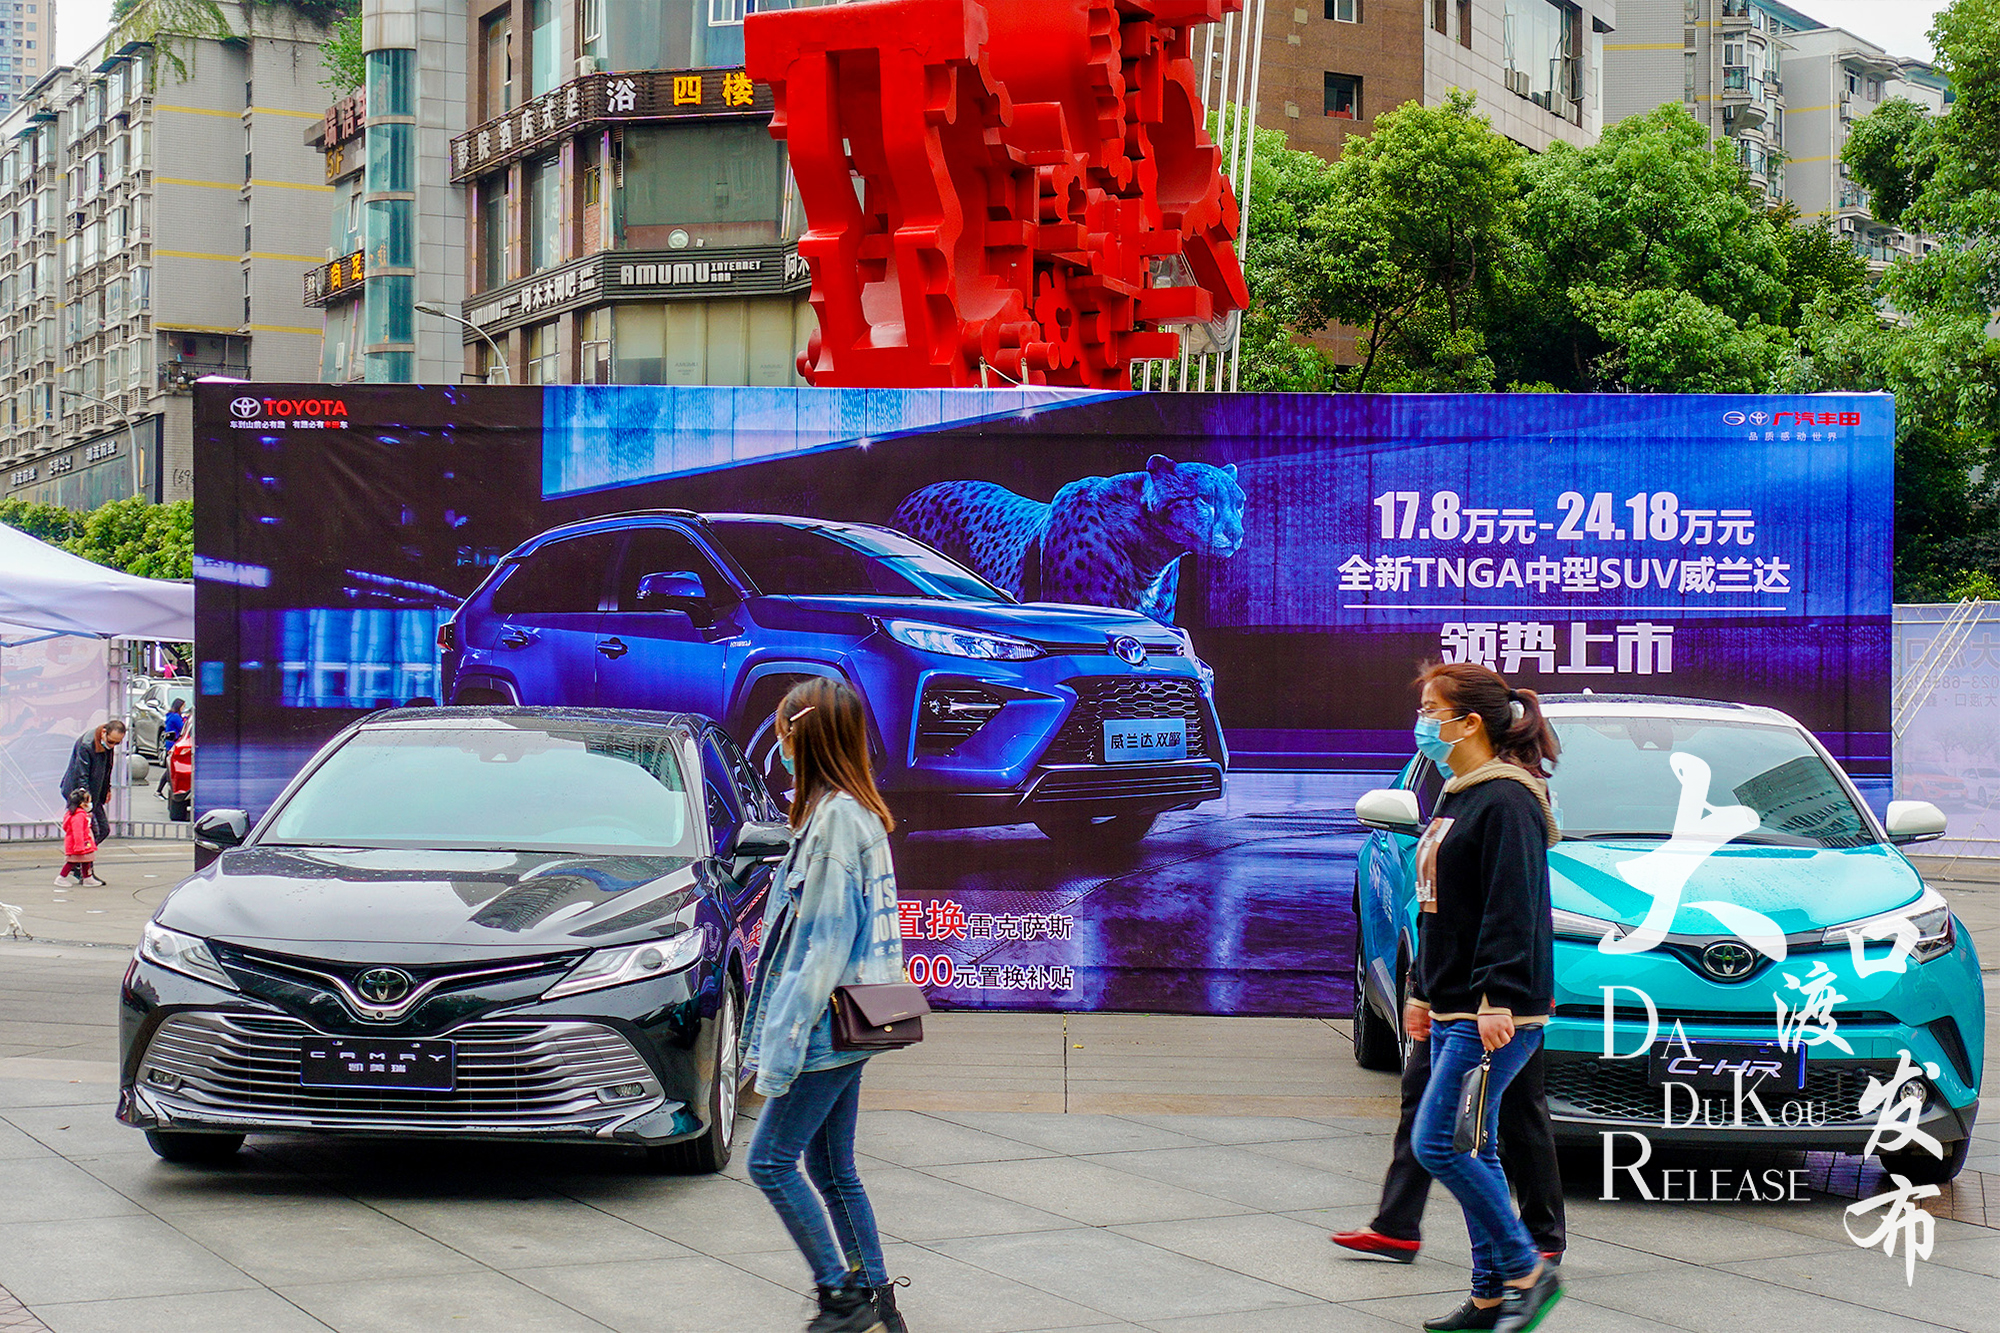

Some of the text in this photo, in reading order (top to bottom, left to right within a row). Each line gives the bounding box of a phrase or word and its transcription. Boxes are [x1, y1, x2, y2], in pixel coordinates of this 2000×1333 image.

[457, 72, 754, 170] 影院酒店式足浴 四楼
[326, 145, 345, 179] 5F
[620, 260, 761, 286] AMUMU INTERNET
[710, 273, 731, 282] BAR
[521, 271, 577, 314] 阿木木网吧
[263, 399, 348, 416] TOYOTA
[1772, 411, 1861, 426] 广汽丰田
[1748, 431, 1837, 442] 品质感动世界
[1373, 491, 1755, 545] 17.8万元-24.18万元
[1337, 555, 1791, 594] 全新TNGA中型SUV威兰达
[1440, 622, 1675, 675] 领势上市
[310, 1051, 447, 1062] CAMRY
[1667, 1057, 1783, 1078] C-HR
